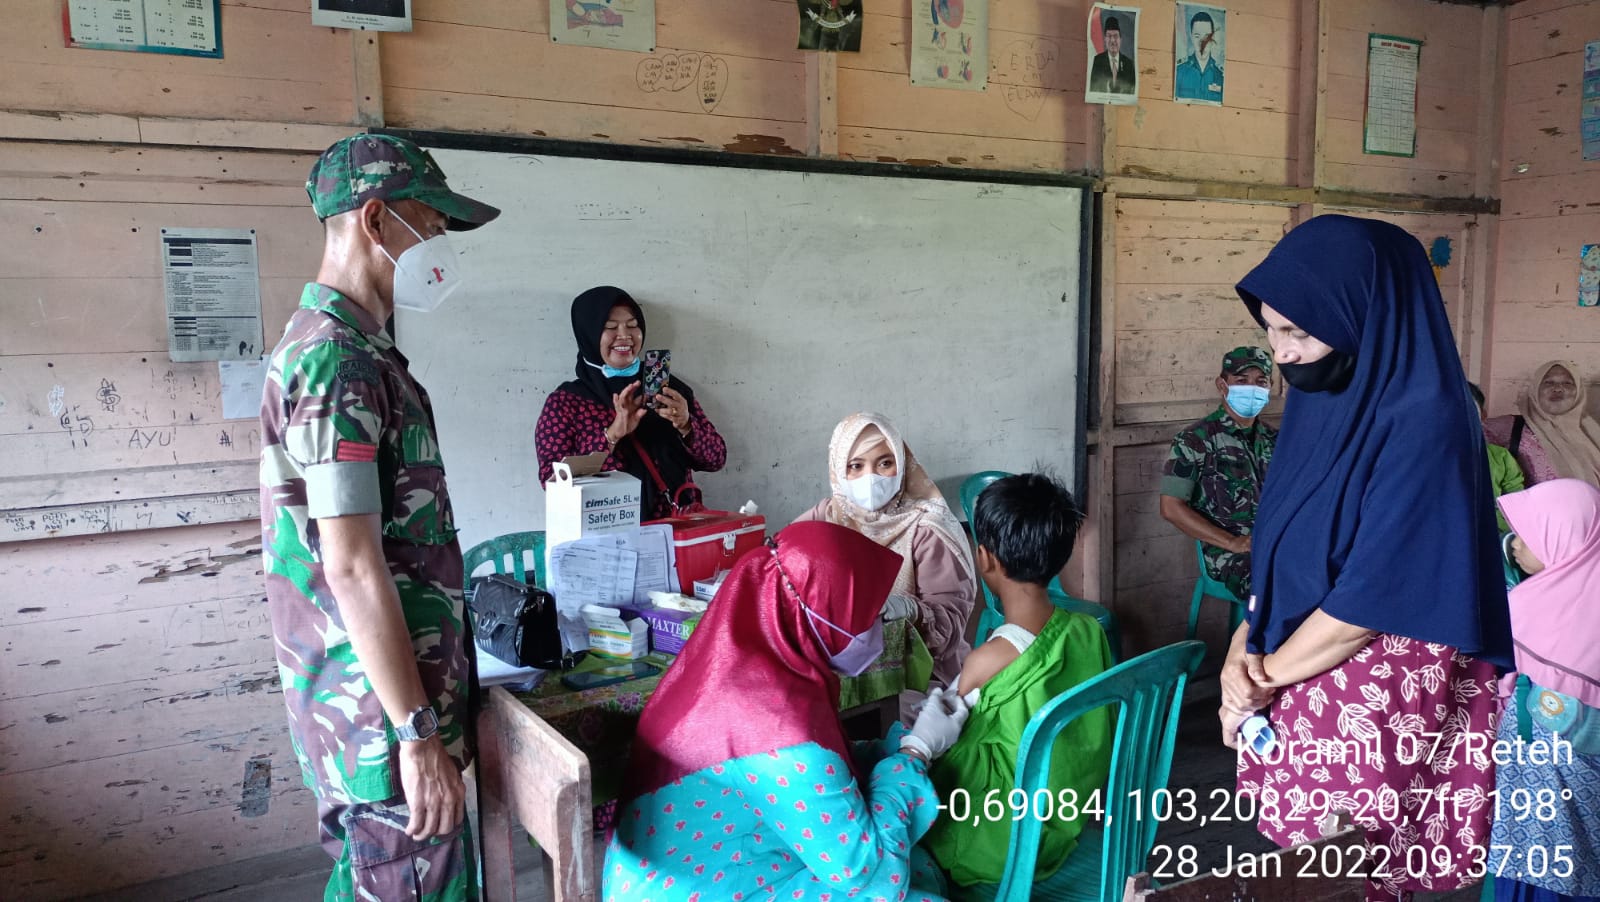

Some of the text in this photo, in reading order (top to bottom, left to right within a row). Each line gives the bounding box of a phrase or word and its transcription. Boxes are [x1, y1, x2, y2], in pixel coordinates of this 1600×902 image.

[129, 429, 171, 450] AYU
[588, 509, 635, 524] Safety Box
[647, 616, 690, 637] MAXTER
